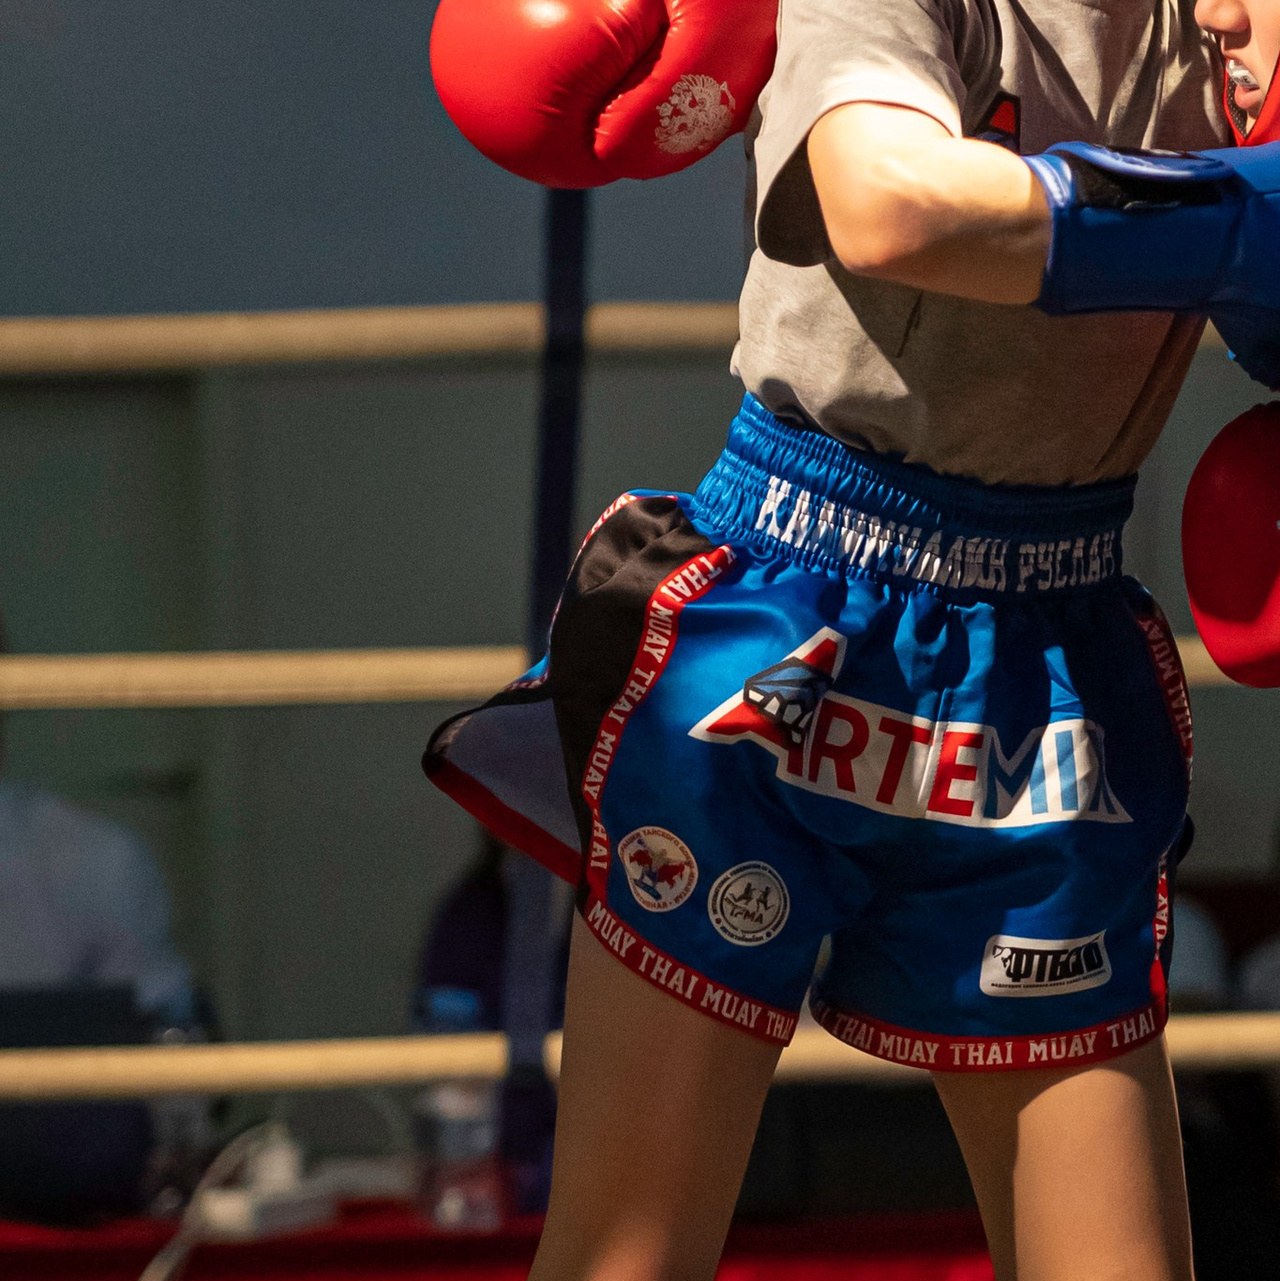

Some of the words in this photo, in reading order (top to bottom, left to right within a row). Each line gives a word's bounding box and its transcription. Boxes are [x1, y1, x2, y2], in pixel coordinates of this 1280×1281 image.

[658, 554, 723, 603] THAI
[641, 599, 675, 665] MUAY
[607, 666, 657, 725] THAI
[582, 729, 617, 801] MUAY
[587, 899, 637, 959] MUAY
[637, 944, 701, 1001] THAI
[700, 981, 764, 1030] MUAY
[833, 1011, 876, 1052] THAI
[879, 1030, 940, 1065] MUAY
[949, 1041, 1015, 1067] THAI
[1027, 1030, 1099, 1064] MUAY
[1105, 1007, 1157, 1049] THAI
